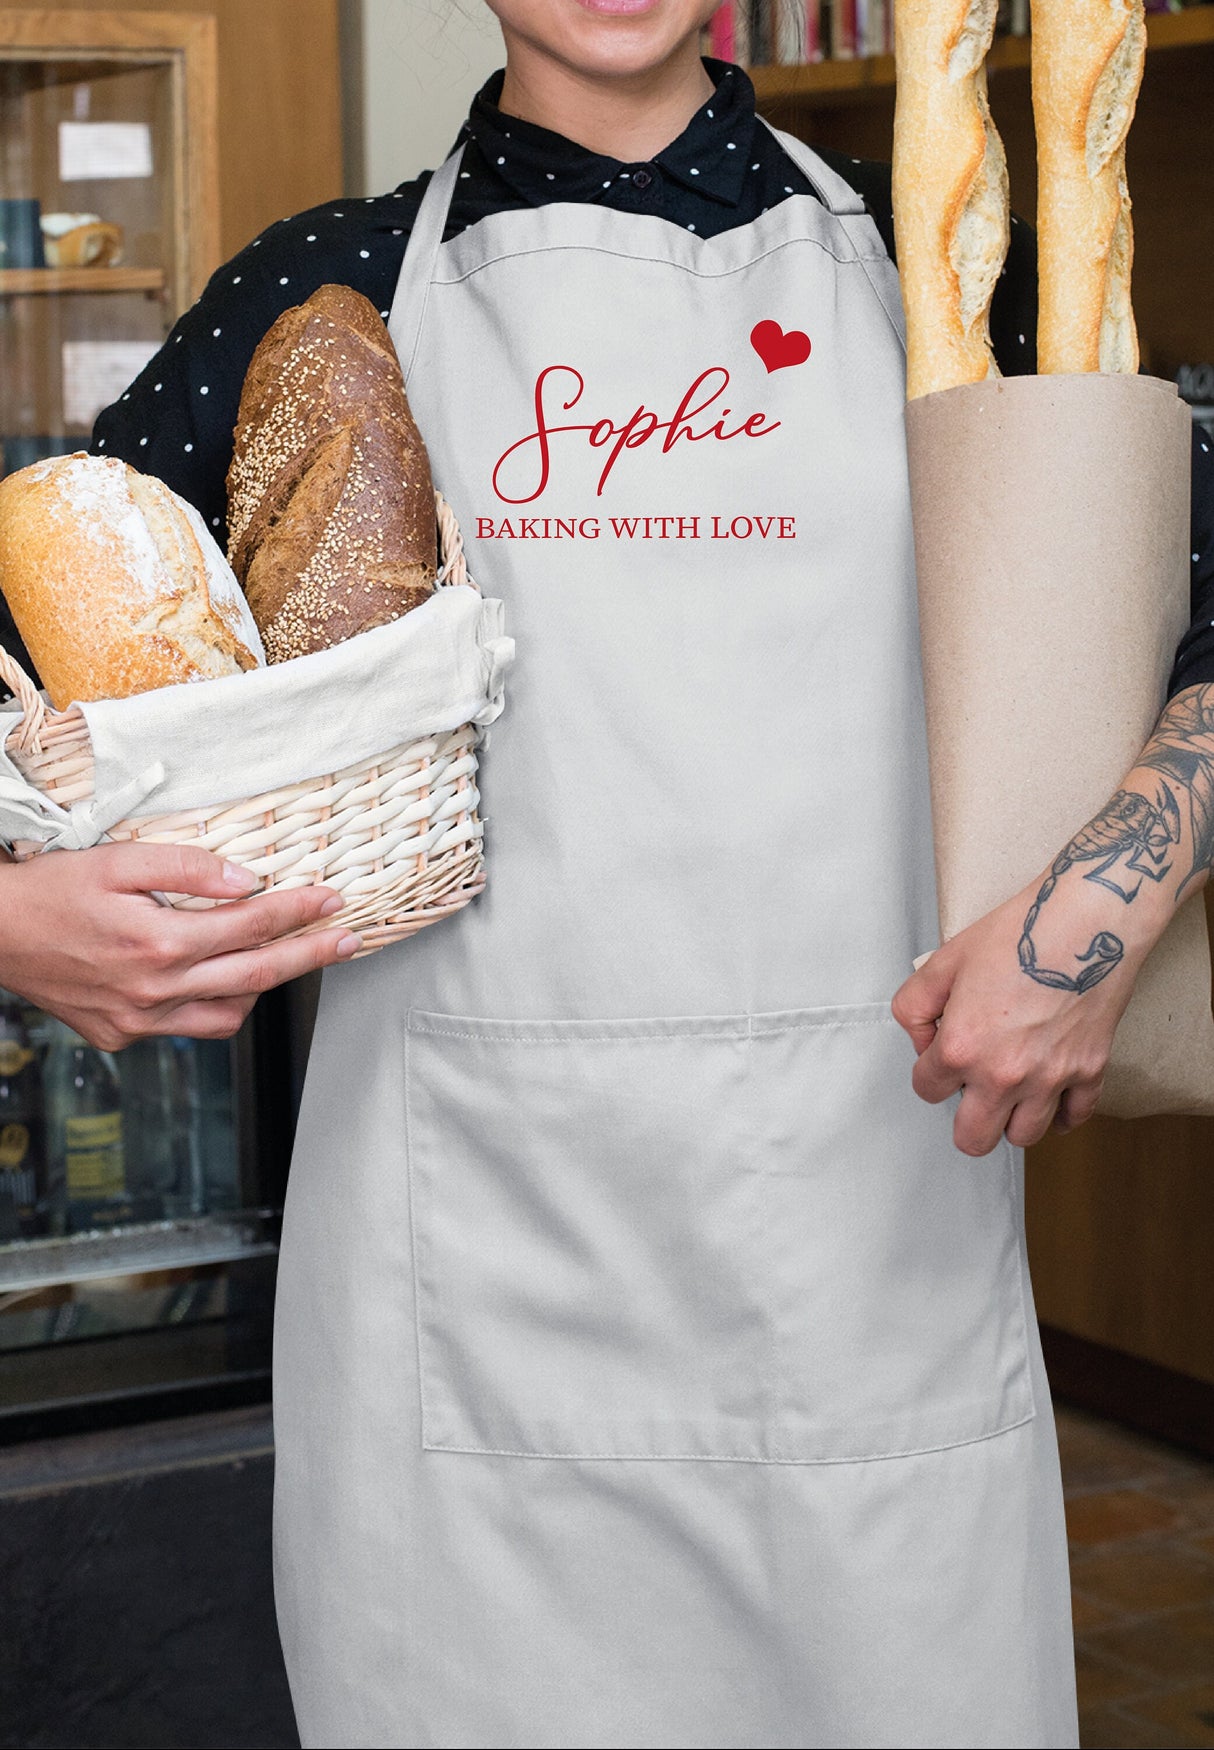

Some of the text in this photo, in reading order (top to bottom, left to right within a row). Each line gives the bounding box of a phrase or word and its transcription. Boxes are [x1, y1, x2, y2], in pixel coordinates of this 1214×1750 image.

[492, 365, 781, 504] Sophie
[475, 516, 796, 539] BAKING WITH LOVE
